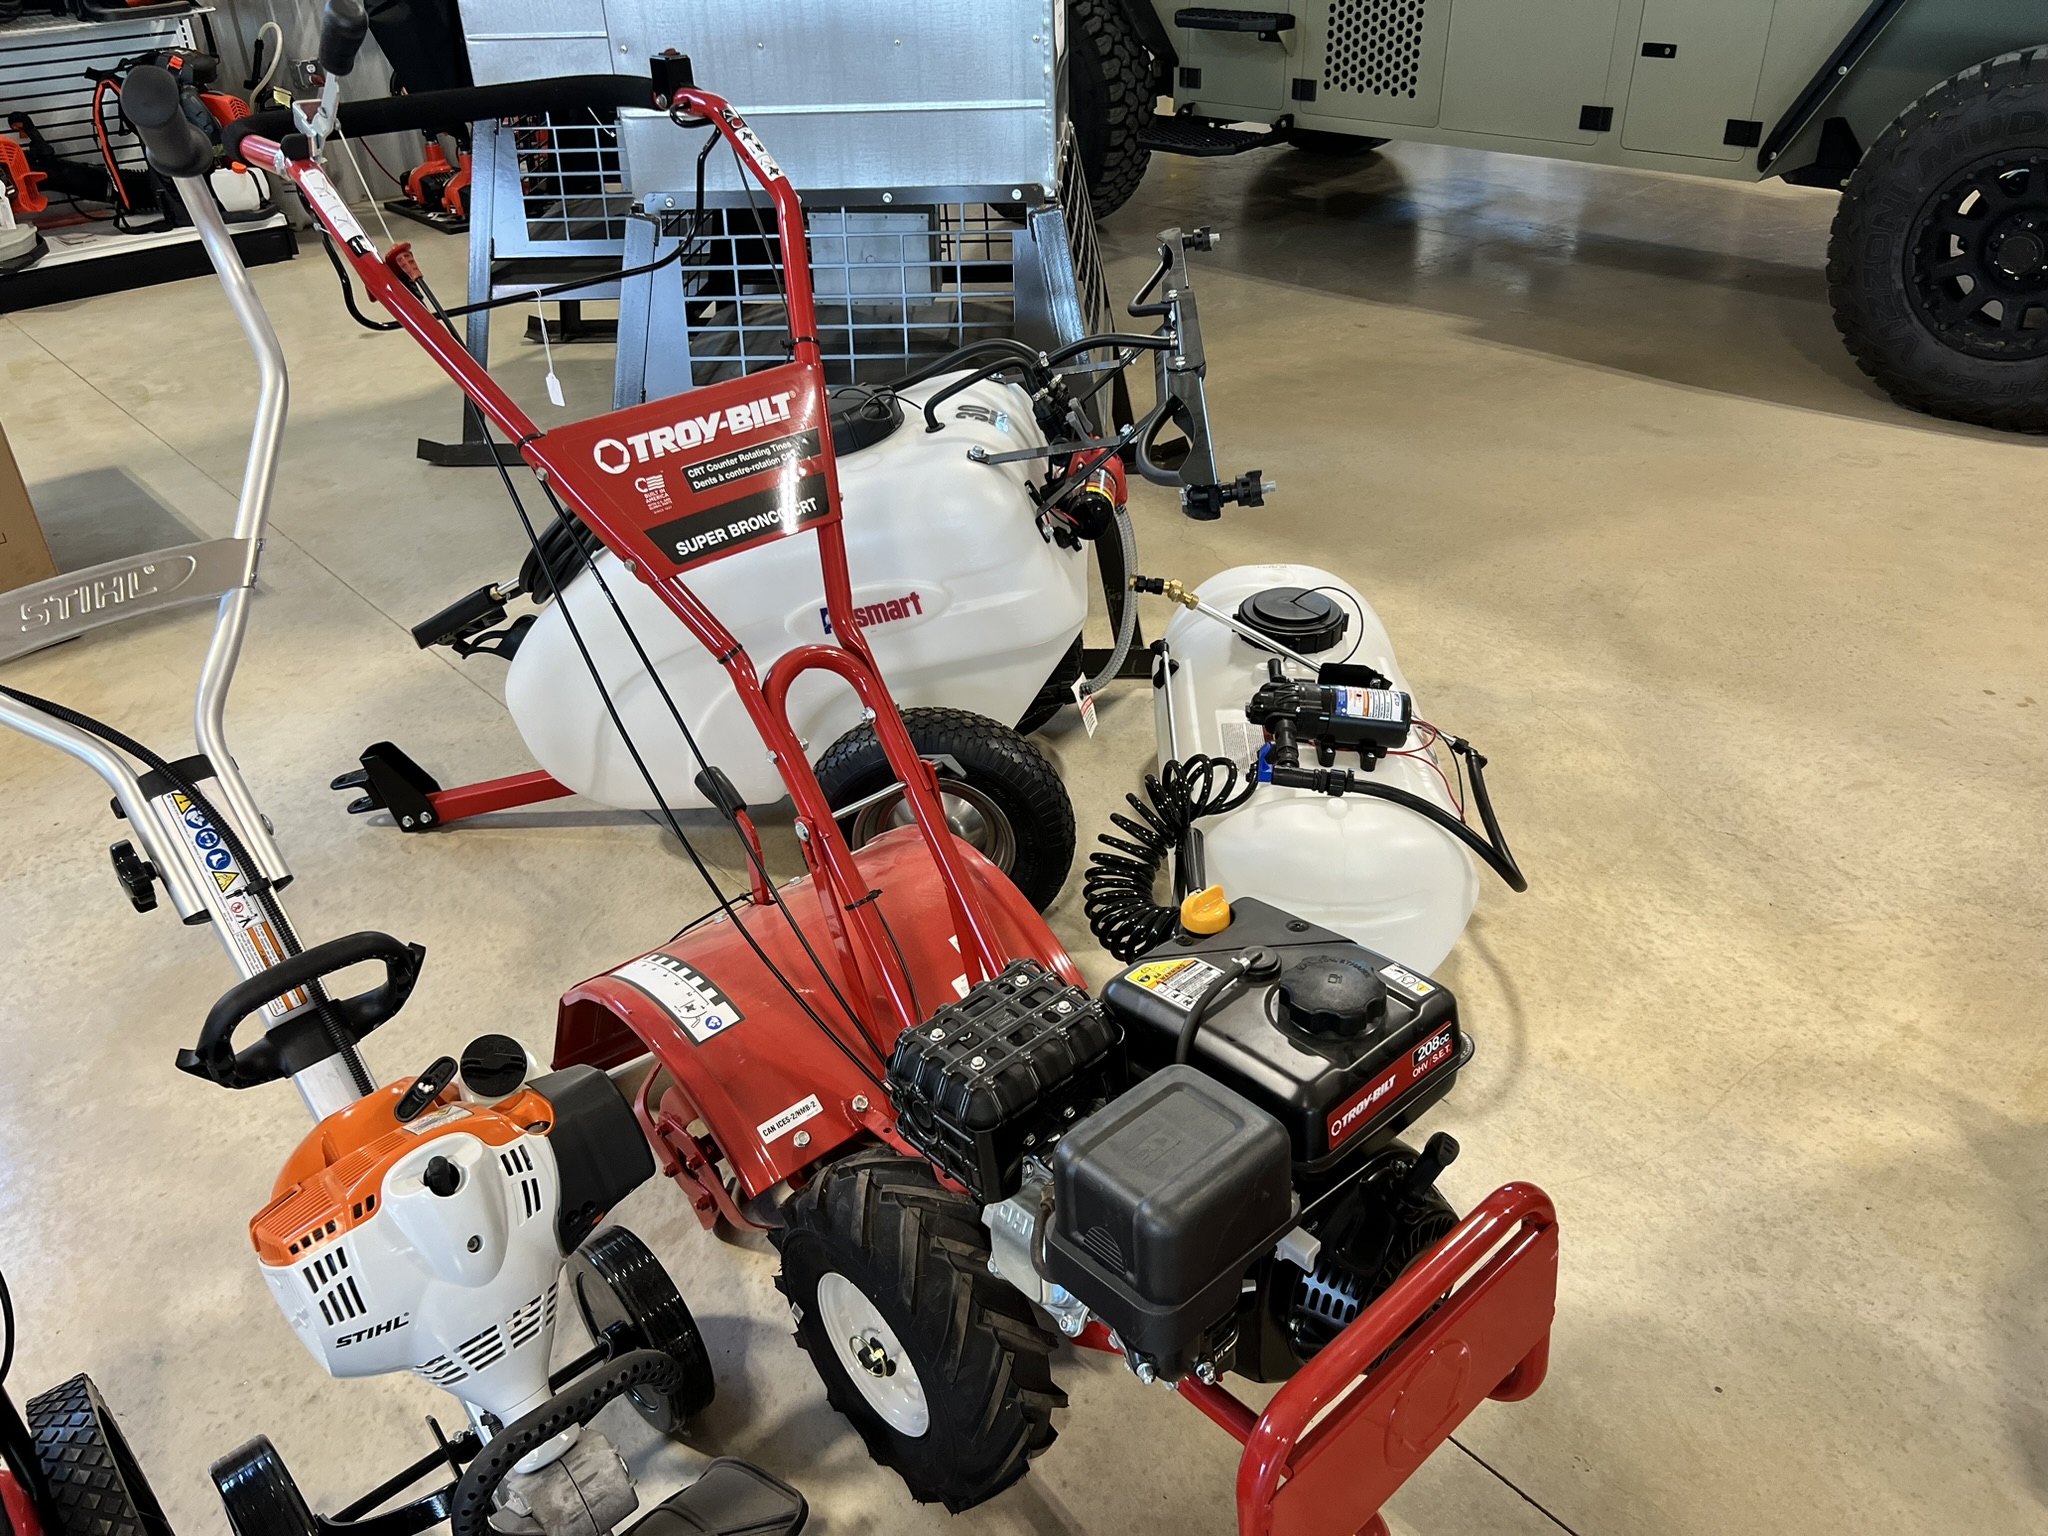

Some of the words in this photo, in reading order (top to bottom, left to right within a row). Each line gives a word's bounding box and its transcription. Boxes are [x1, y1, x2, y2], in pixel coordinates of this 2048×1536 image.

[627, 392, 792, 463] TROY-BILT
[687, 465, 706, 479] CRT
[707, 456, 738, 472] Counter
[739, 446, 771, 465] Rotating
[770, 441, 792, 453] Tines
[693, 477, 718, 490] Dents
[718, 473, 726, 482] à
[726, 457, 781, 480] contre-rotation
[676, 528, 729, 556] SUPER
[20, 571, 158, 632] STIHL
[762, 1124, 777, 1137] CAN
[776, 1100, 817, 1130] ICES-2/NMB-2
[1341, 1074, 1397, 1128] TROY-BILT
[335, 1315, 410, 1349] STIHL
